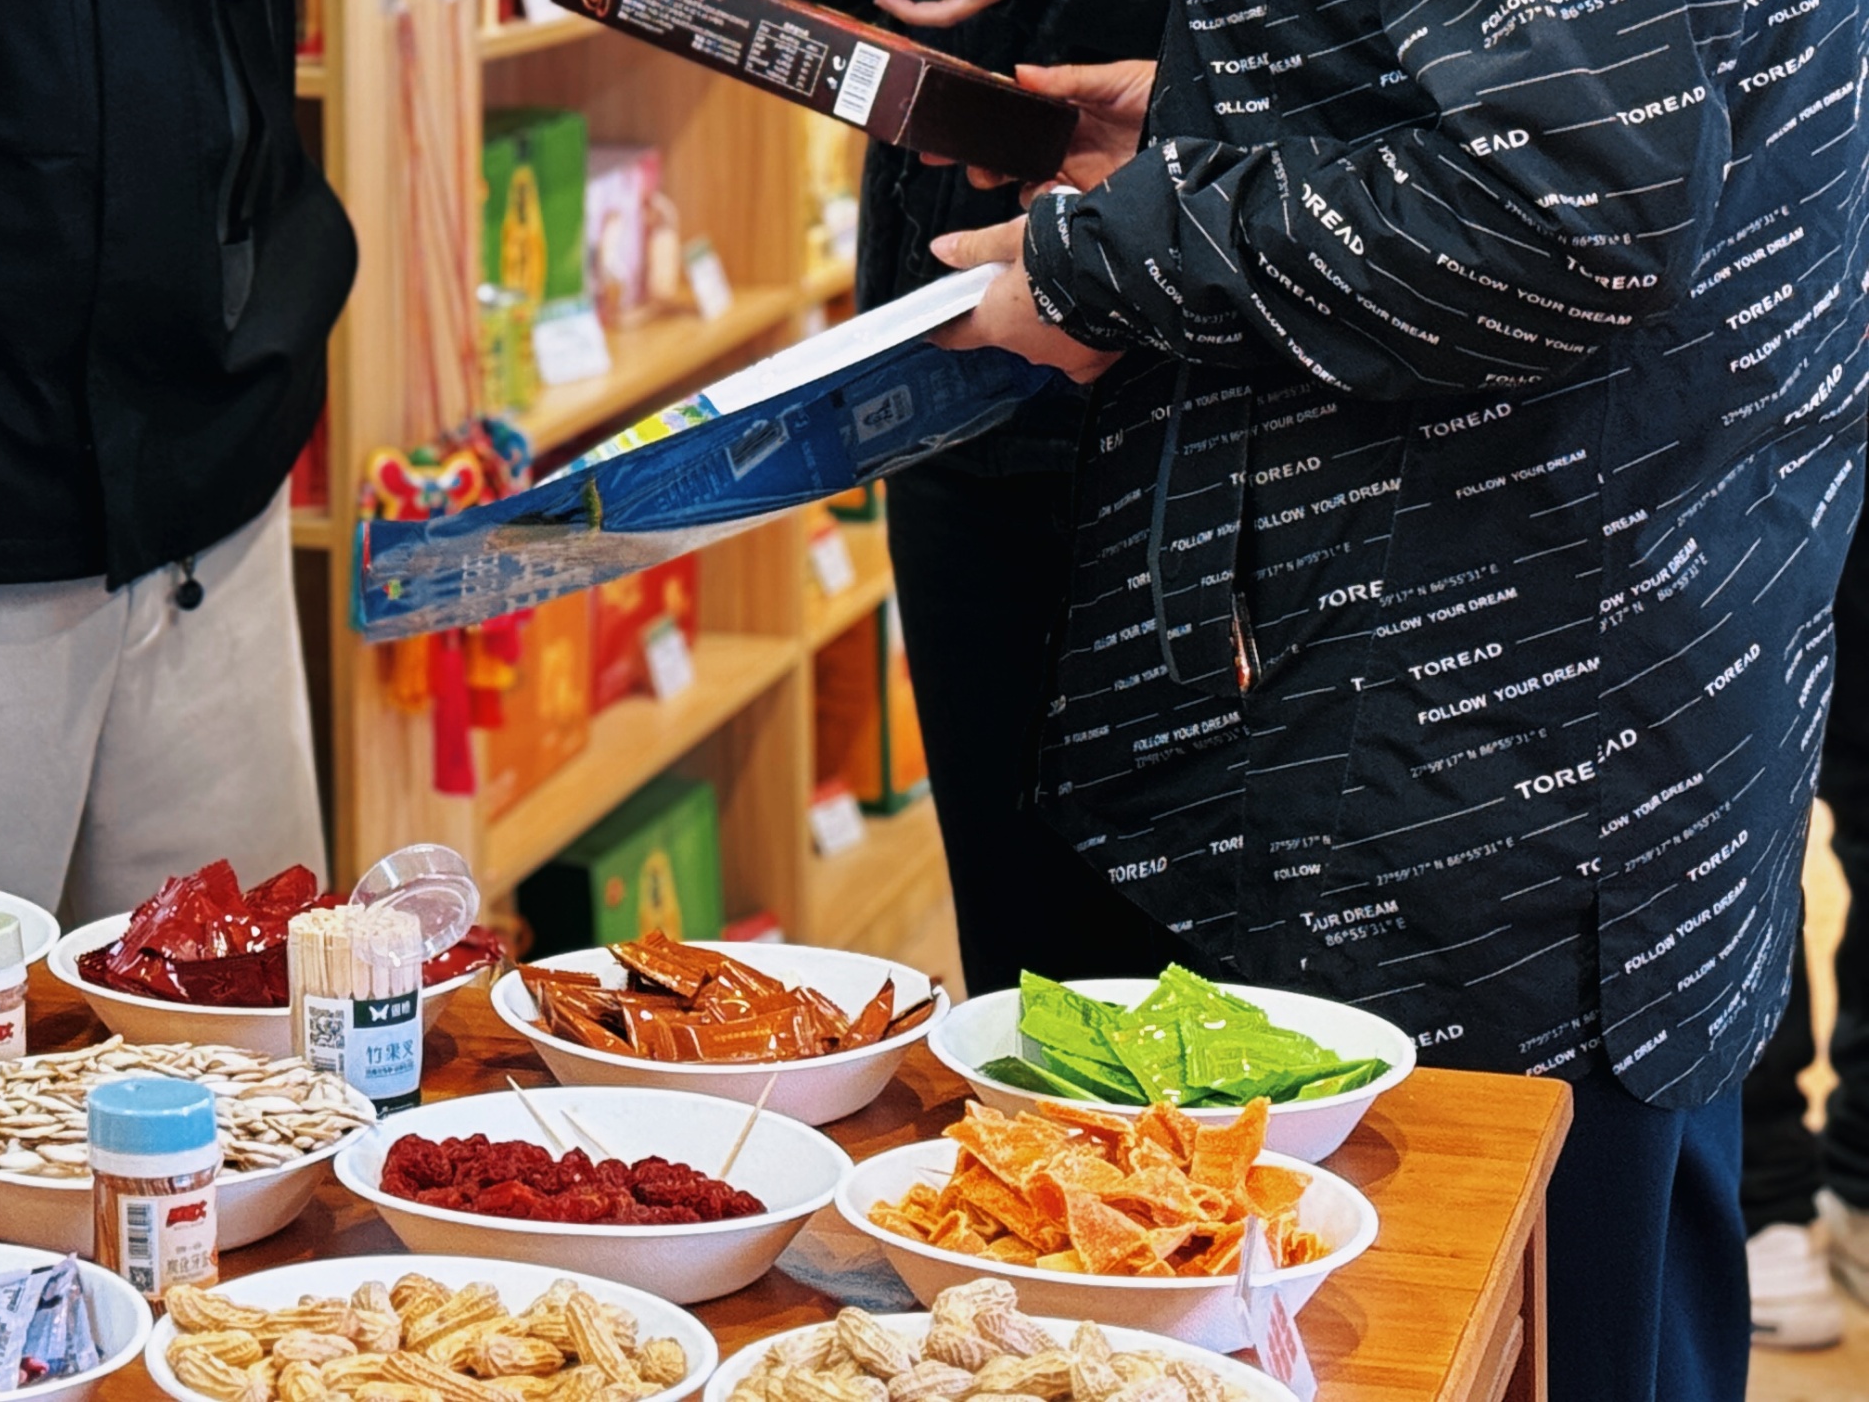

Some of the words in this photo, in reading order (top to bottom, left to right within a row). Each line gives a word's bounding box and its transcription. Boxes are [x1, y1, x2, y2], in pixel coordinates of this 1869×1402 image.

[1738, 45, 1816, 93] TOREAD
[1616, 85, 1707, 127] TOREAD
[1732, 247, 1768, 272] YOUR
[1765, 225, 1806, 256] DREAM
[1143, 257, 1184, 305] FOLLOW
[1258, 251, 1332, 316] TOREAD
[1307, 251, 1353, 296] FOLLOW
[1355, 293, 1392, 322] YOUR
[1391, 314, 1441, 346] DREAM
[1436, 252, 1509, 292] FOLLOW
[1516, 287, 1565, 313] YOUR
[1568, 306, 1633, 326] DREAM
[1033, 286, 1065, 323] YOUR
[1725, 283, 1794, 331] TOREAD
[1477, 314, 1539, 344] FOLLOW
[1543, 336, 1586, 355] YOUR
[1730, 333, 1782, 375] FOLLOW
[1261, 414, 1295, 438] YOUR
[1295, 402, 1338, 424] DREAM
[1418, 402, 1513, 441] TOREAD
[1455, 475, 1508, 500] FOLLOW
[1510, 464, 1547, 483] YOUR
[1545, 448, 1588, 473] DREAM
[1309, 491, 1347, 516] YOUR
[1348, 477, 1402, 504] DREAM
[1602, 508, 1648, 538] DREAM
[1318, 579, 1386, 611] TORE
[1629, 562, 1673, 597] YOUR
[1376, 615, 1424, 639] OLLOW
[1426, 602, 1468, 625] YOUR
[1468, 586, 1520, 612] DREAM
[1408, 642, 1504, 682] TOREAD
[1703, 642, 1762, 699] TOREAD
[1417, 693, 1488, 726] FOLLOW
[1492, 676, 1542, 703] YOUR
[1541, 656, 1601, 688] DREAM
[1201, 710, 1243, 733] DREAM
[1632, 795, 1666, 820] YOUR
[1660, 772, 1704, 802] DREAM
[1107, 855, 1168, 885] TOREAD
[1273, 863, 1322, 882] FOLLOW
[1687, 829, 1749, 882] TOREAD
[1342, 898, 1400, 924] DREAM
[1395, 916, 1407, 930] E
[1623, 932, 1677, 975] FOLLOW
[1675, 909, 1713, 939] YOUR
[1711, 876, 1749, 917] DREAM
[1524, 1047, 1577, 1078] FOLLOW
[1612, 1054, 1634, 1076] OUR
[1632, 1028, 1669, 1062] DREAM
